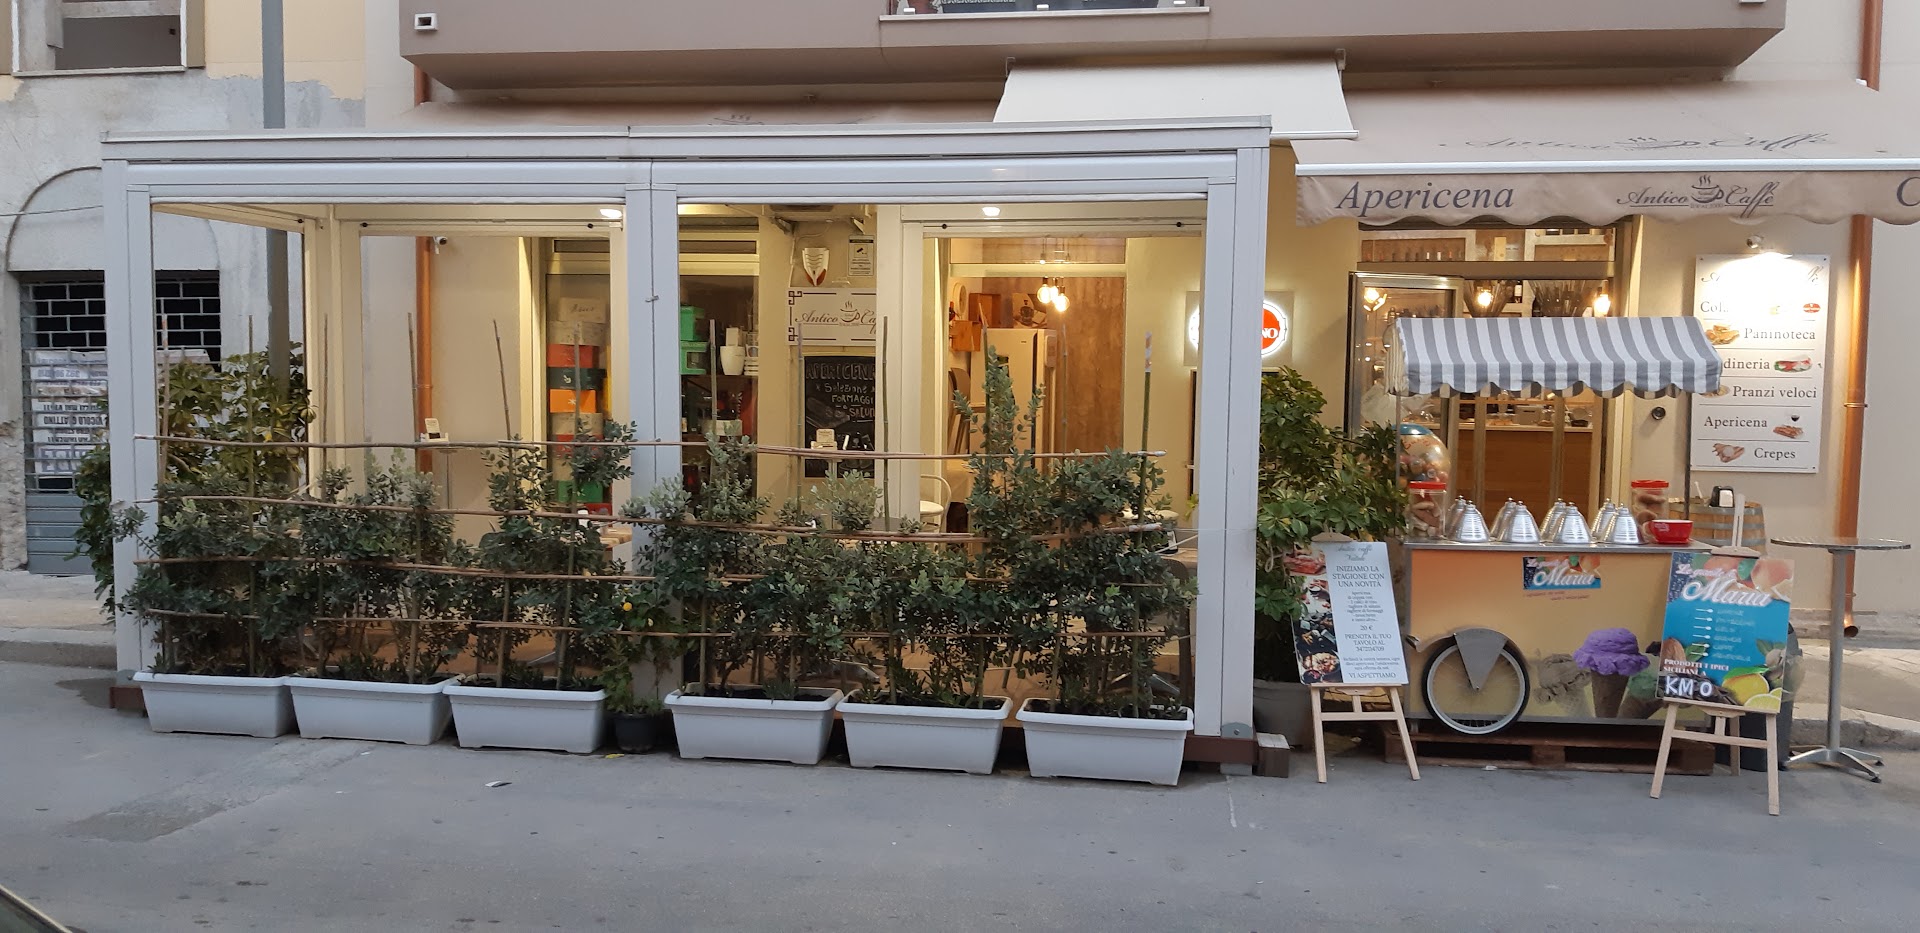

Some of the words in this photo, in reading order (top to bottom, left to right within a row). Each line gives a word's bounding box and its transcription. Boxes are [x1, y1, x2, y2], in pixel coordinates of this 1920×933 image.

[1896, 176, 1920, 206] C
[1335, 181, 1514, 217] Apericena
[1617, 187, 1689, 204] Antico
[1725, 182, 1779, 218] Caffè
[795, 310, 839, 323] Antico
[1744, 328, 1816, 340] Paninoteca
[1723, 357, 1770, 370] dineria
[1733, 386, 1775, 397] Pranzi
[1779, 387, 1817, 398] veloci
[1704, 416, 1768, 429] Apericena
[1754, 448, 1796, 460] Crepes
[1533, 565, 1595, 586] Maria
[1338, 580, 1353, 588] UNA
[1682, 577, 1773, 607] Maria
[1664, 658, 1703, 669] PRODOTTI
[1663, 666, 1699, 675] SICILIANI
[1665, 676, 1694, 696] KM
